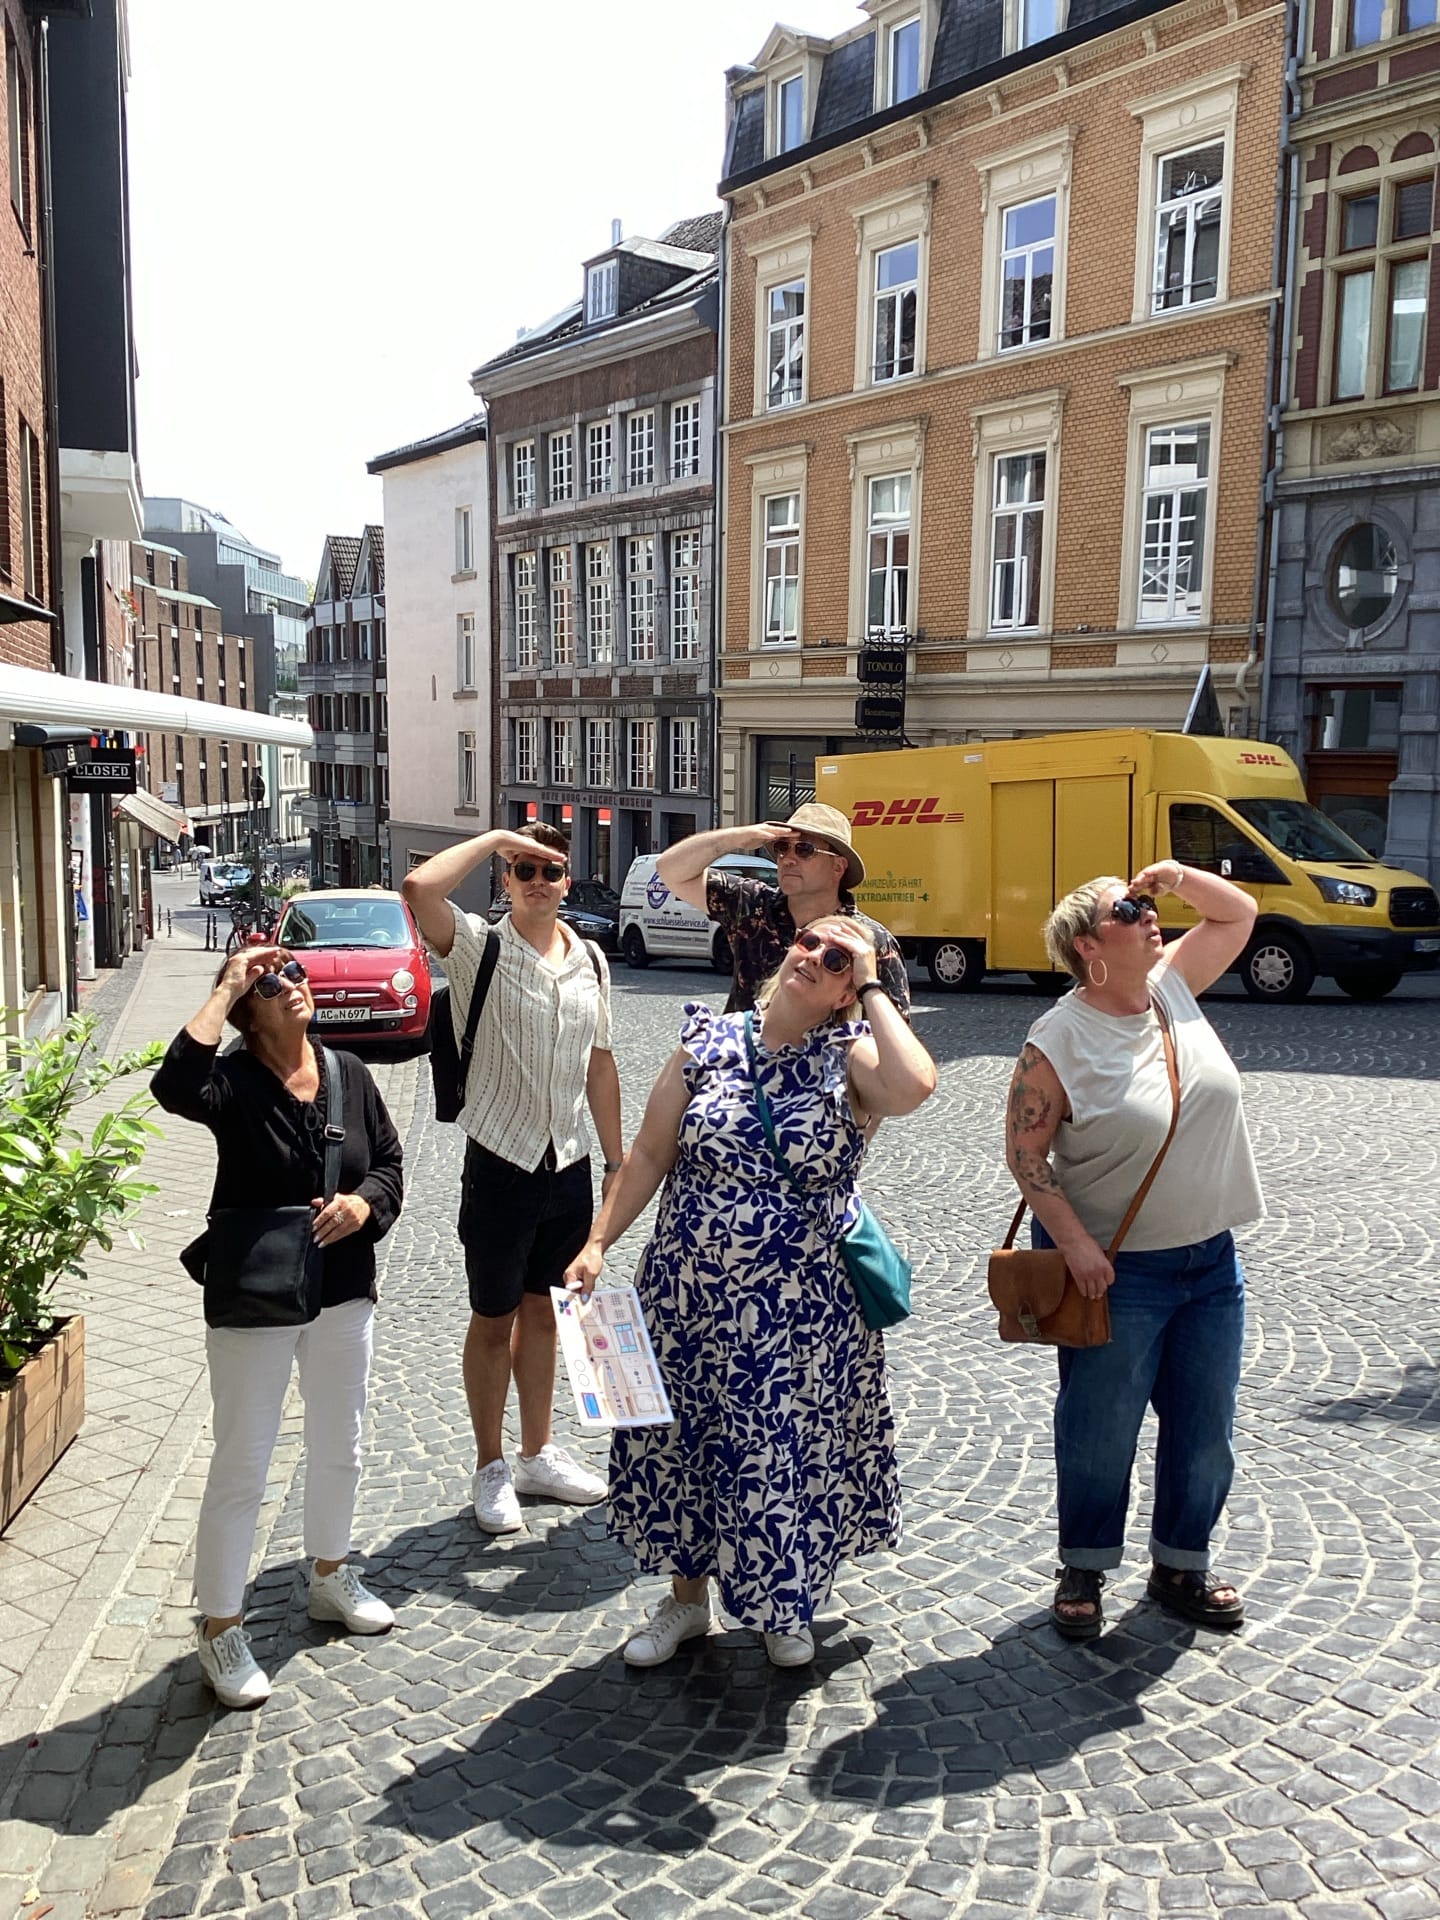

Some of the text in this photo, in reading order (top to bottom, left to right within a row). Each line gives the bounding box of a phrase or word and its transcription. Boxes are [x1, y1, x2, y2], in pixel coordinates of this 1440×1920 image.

[866, 661, 903, 673] TONOLO
[1240, 753, 1282, 766] DHL
[75, 765, 129, 777] CLOSED
[851, 797, 945, 827] DHL
[855, 892, 915, 902] EKTROANTRIEB
[320, 1010, 333, 1020] AC
